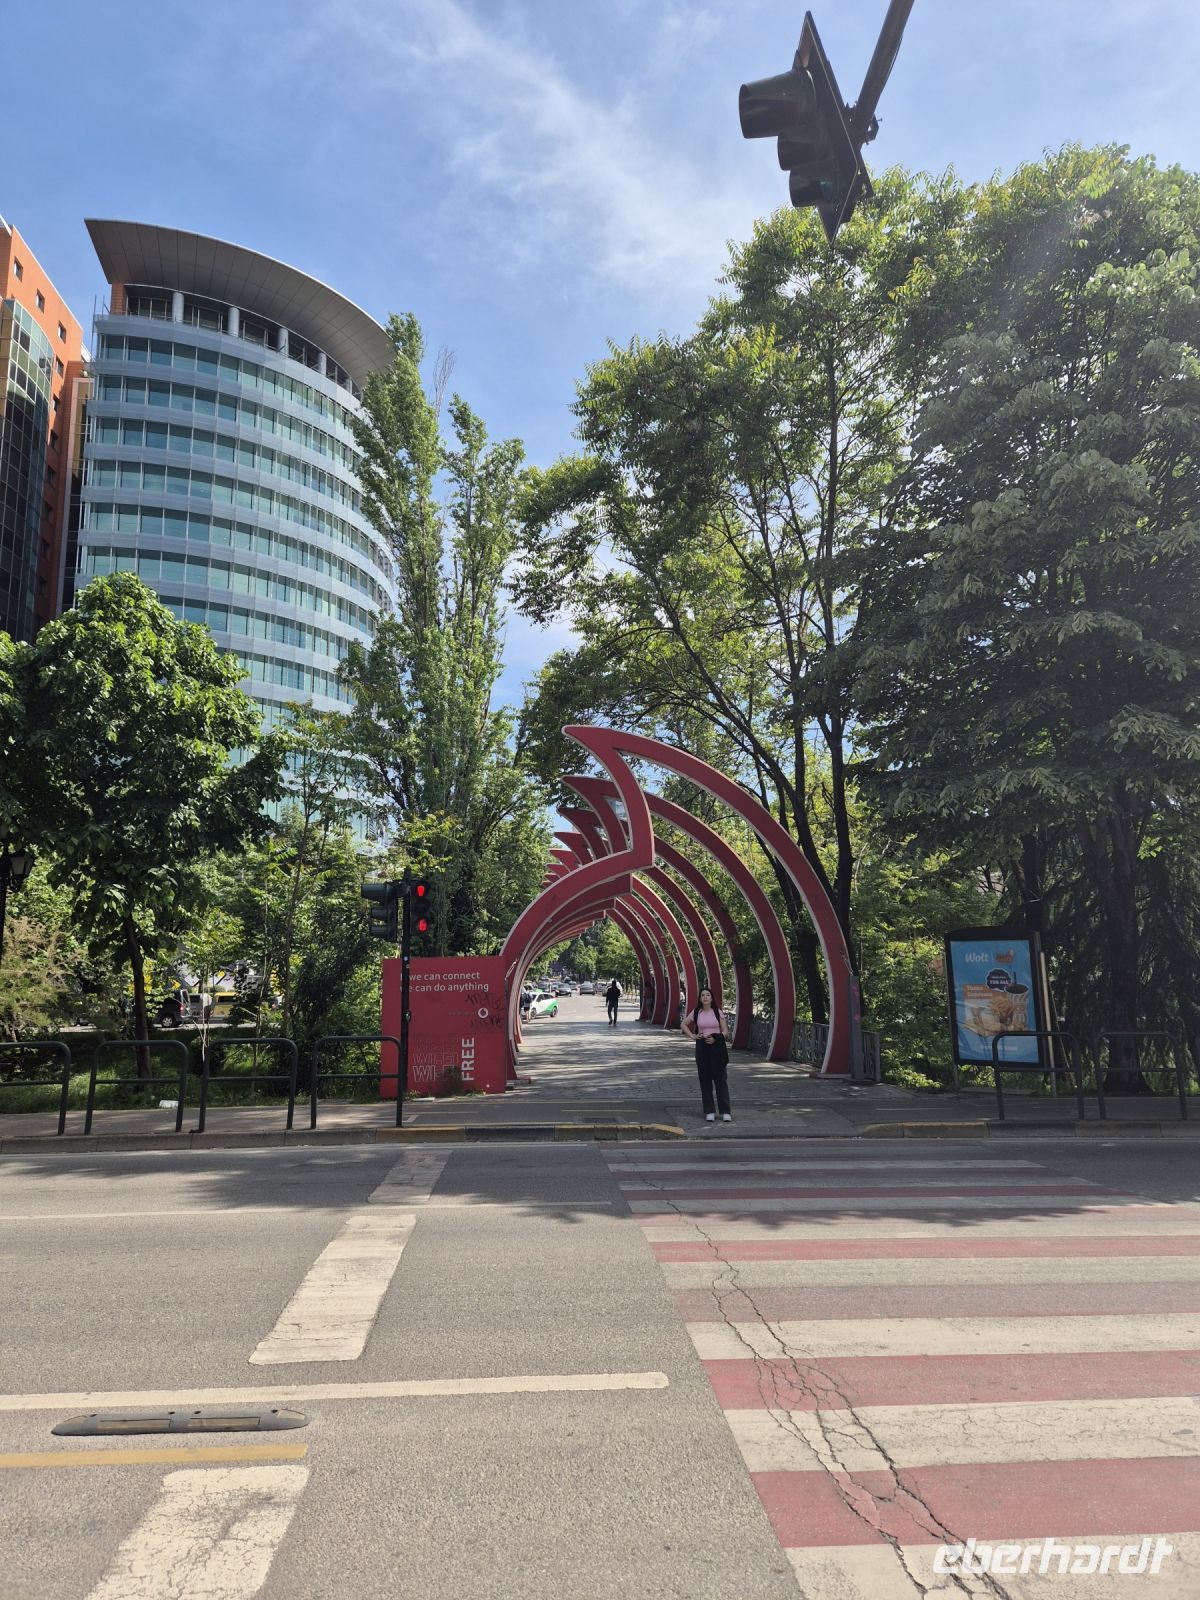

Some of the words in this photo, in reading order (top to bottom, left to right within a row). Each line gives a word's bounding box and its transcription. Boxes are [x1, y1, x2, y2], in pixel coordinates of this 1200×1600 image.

[965, 952, 989, 963] Wolt
[424, 973, 440, 981] can
[442, 971, 480, 980] connect
[415, 984, 432, 992] can
[434, 982, 446, 992] do
[447, 981, 489, 993] anything
[461, 1037, 475, 1081] FREE
